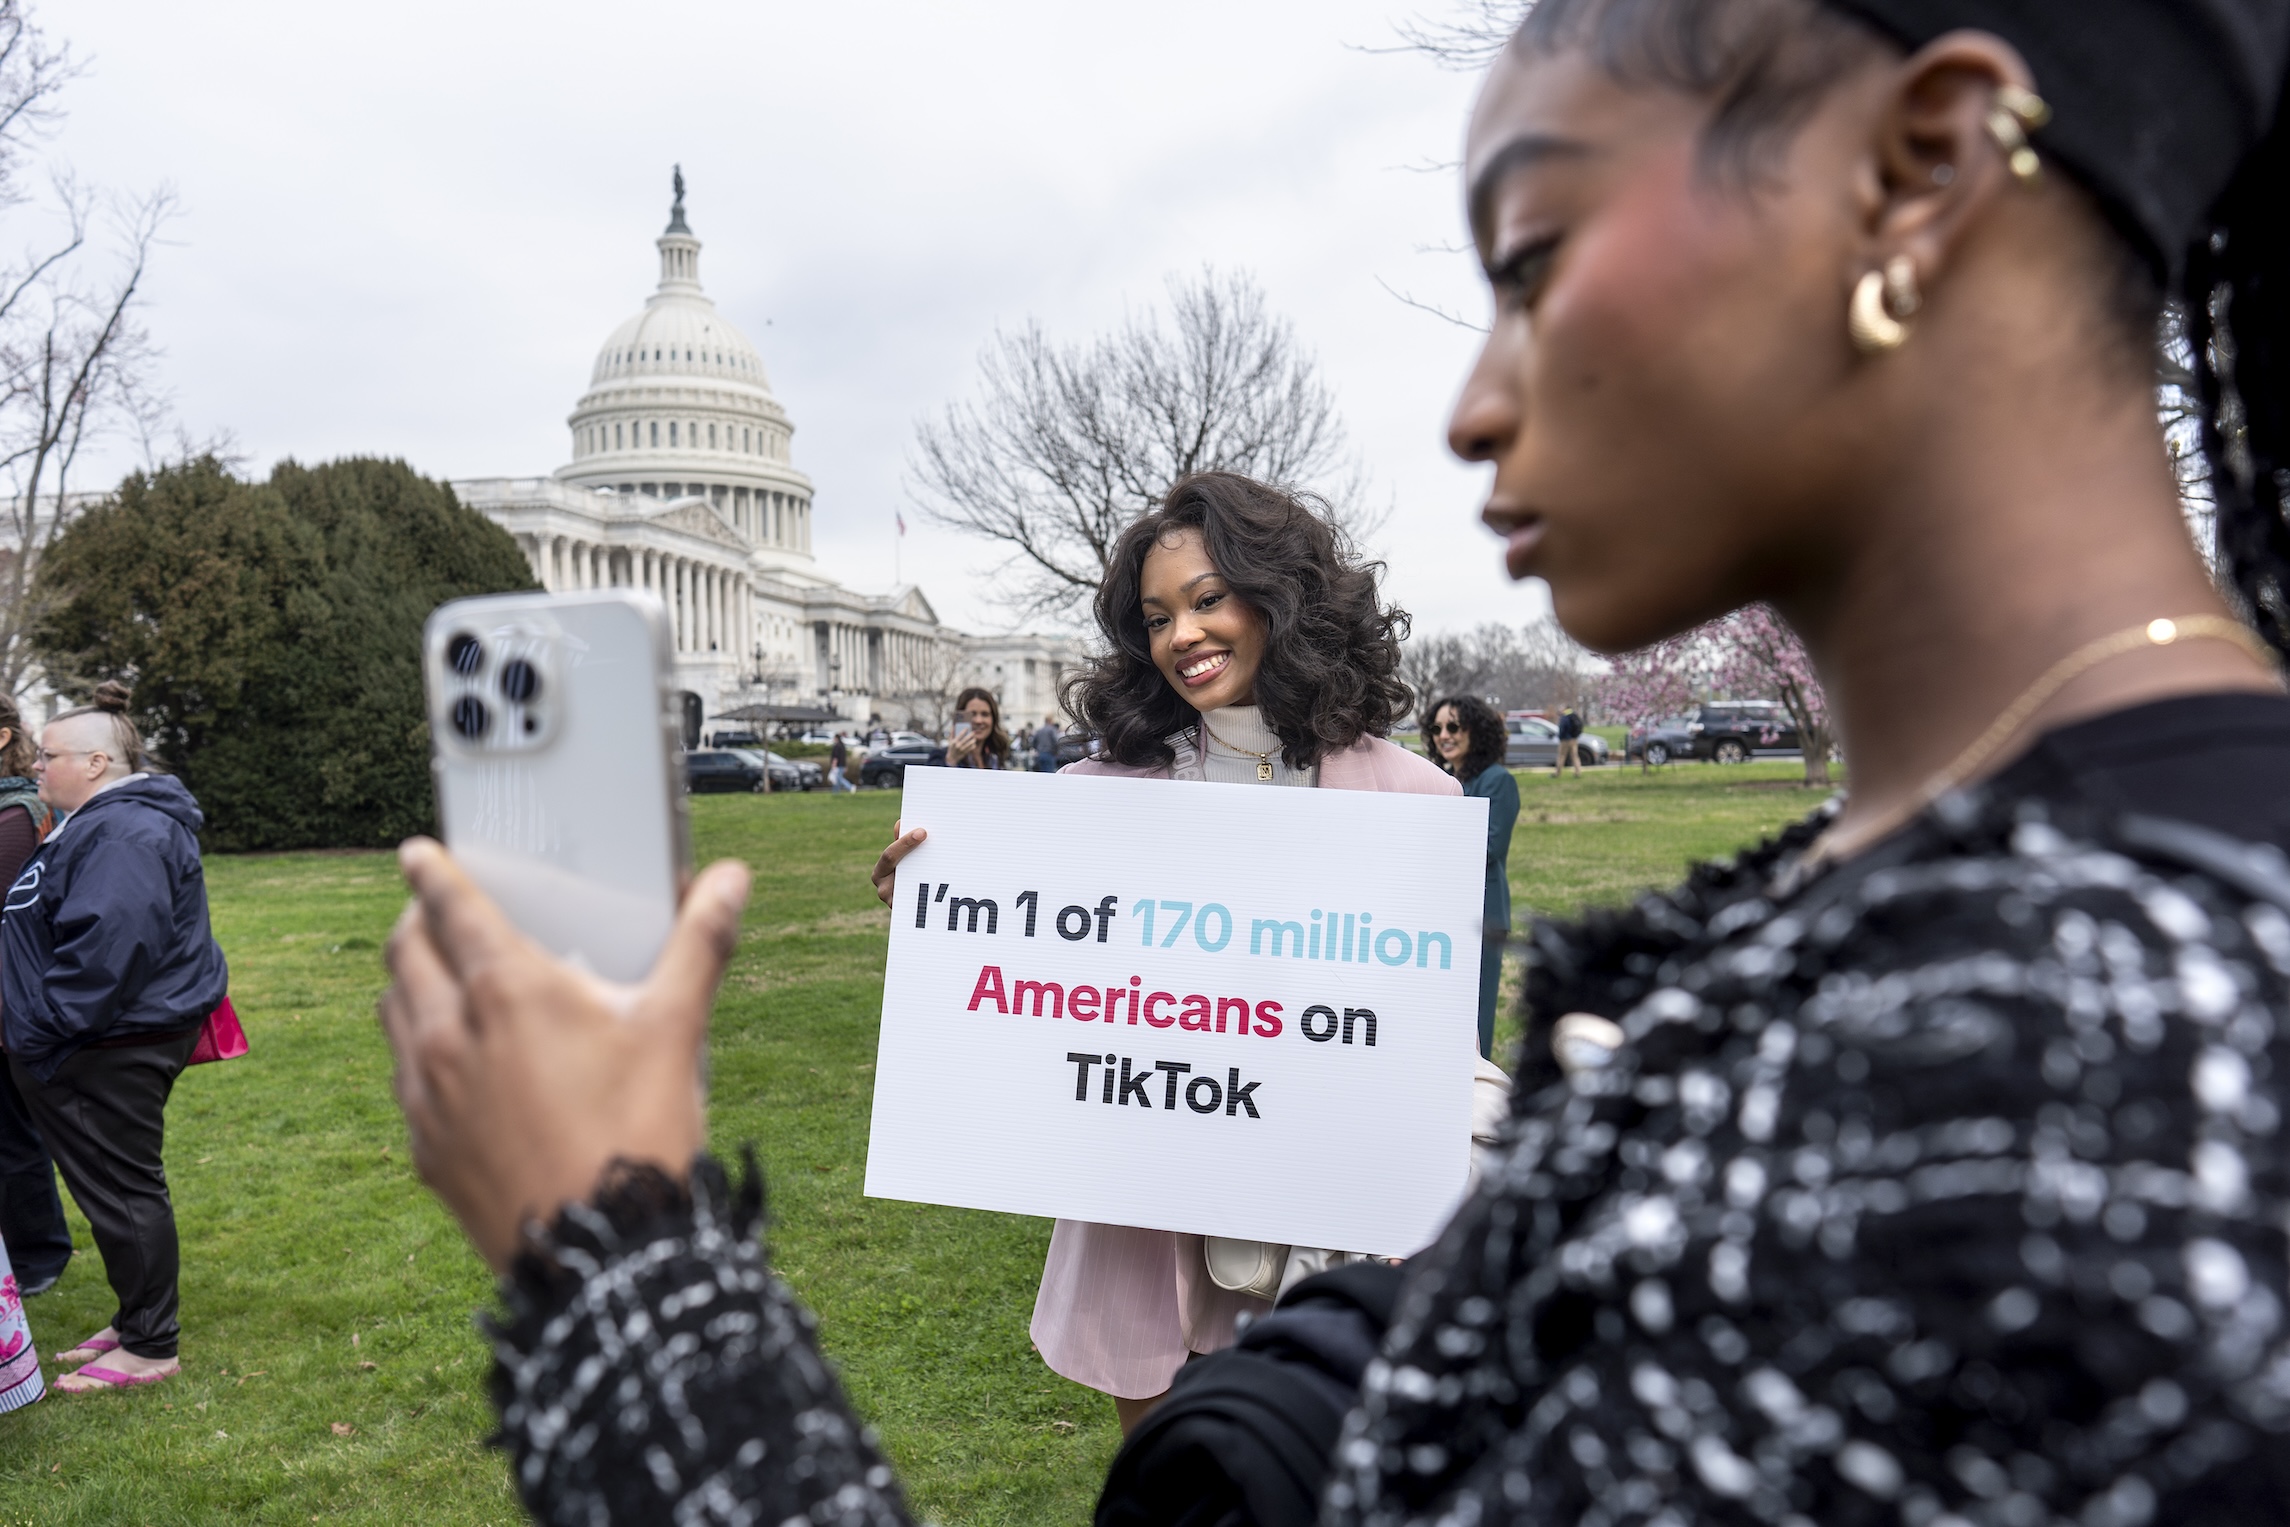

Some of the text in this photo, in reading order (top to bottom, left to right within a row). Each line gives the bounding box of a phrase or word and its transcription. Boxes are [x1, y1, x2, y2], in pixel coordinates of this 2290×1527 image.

[913, 883, 1453, 970] I’m 1 of 170 million
[967, 966, 1378, 1047] Americans on
[1067, 1052, 1262, 1119] TikTok
